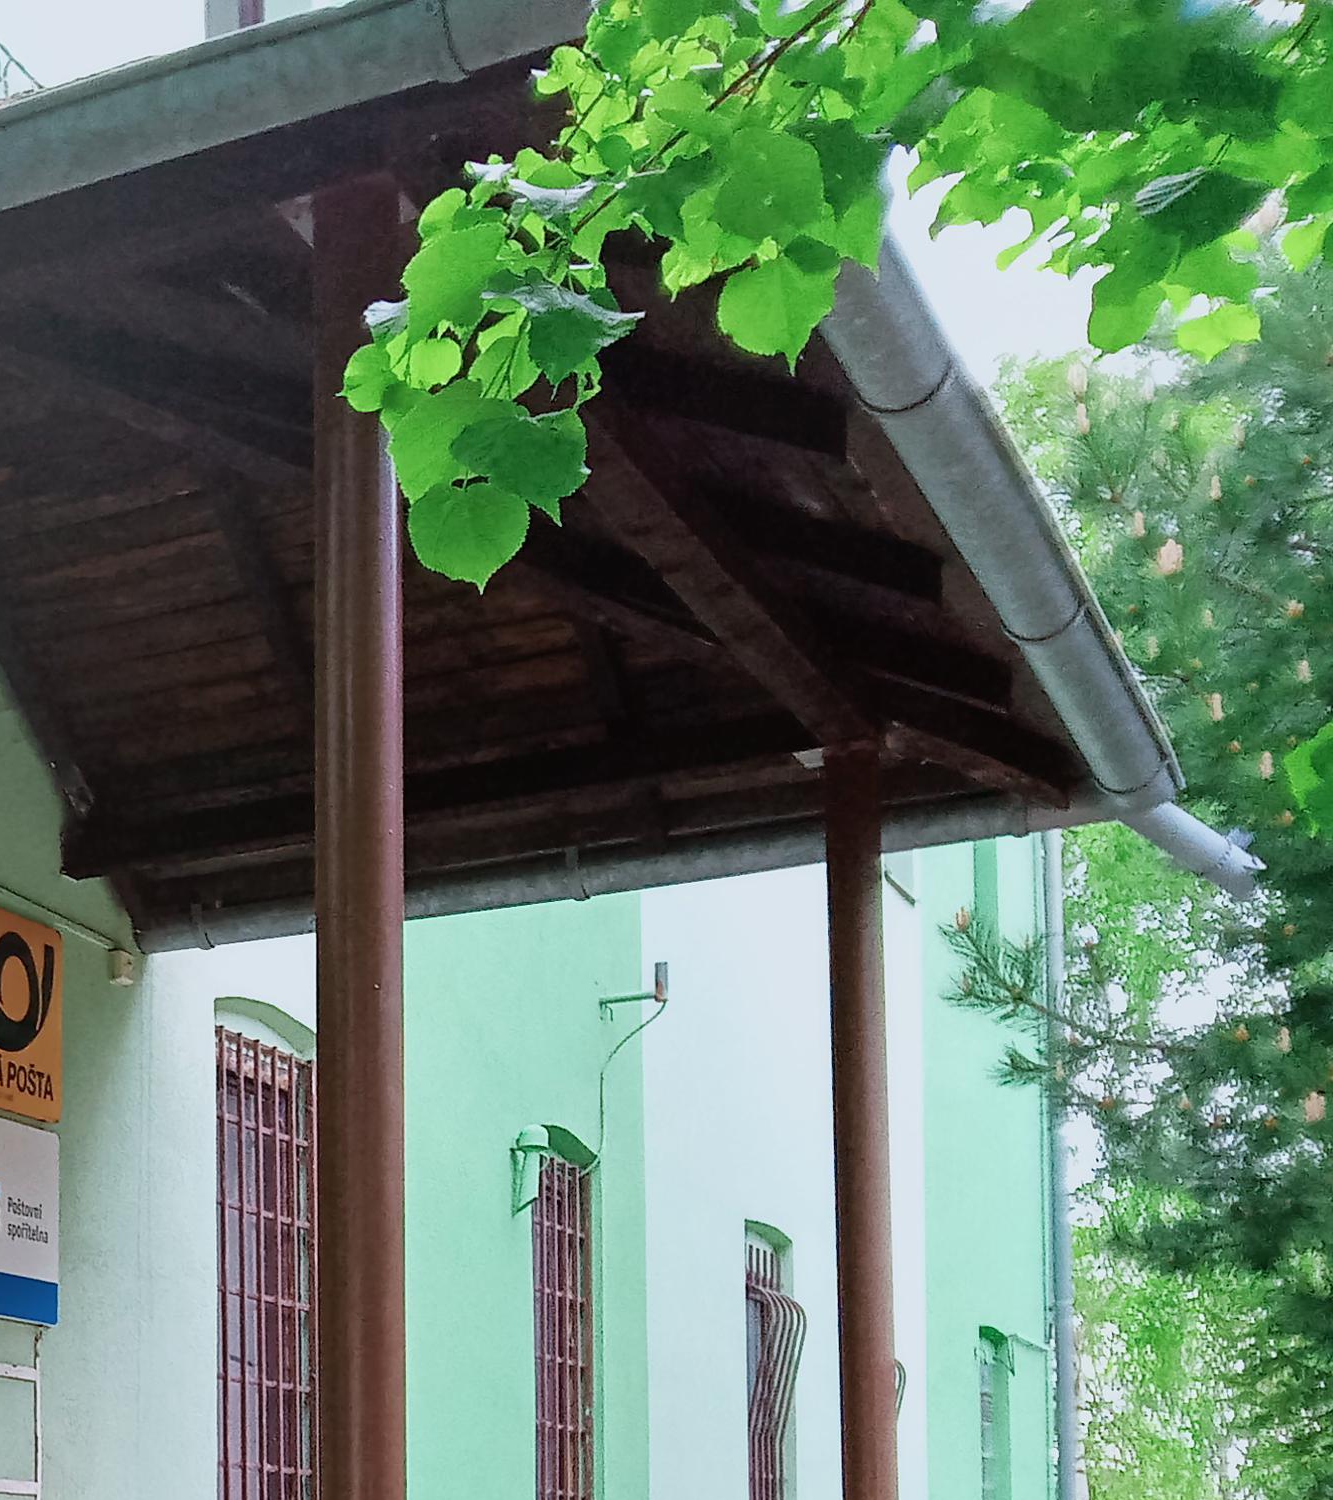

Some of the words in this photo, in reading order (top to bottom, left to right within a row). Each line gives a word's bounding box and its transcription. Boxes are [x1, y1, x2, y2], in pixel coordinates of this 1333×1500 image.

[7, 1061, 53, 1101] POŠTA
[8, 1196, 42, 1219] Poštovní
[8, 1222, 48, 1243] spořitelna
